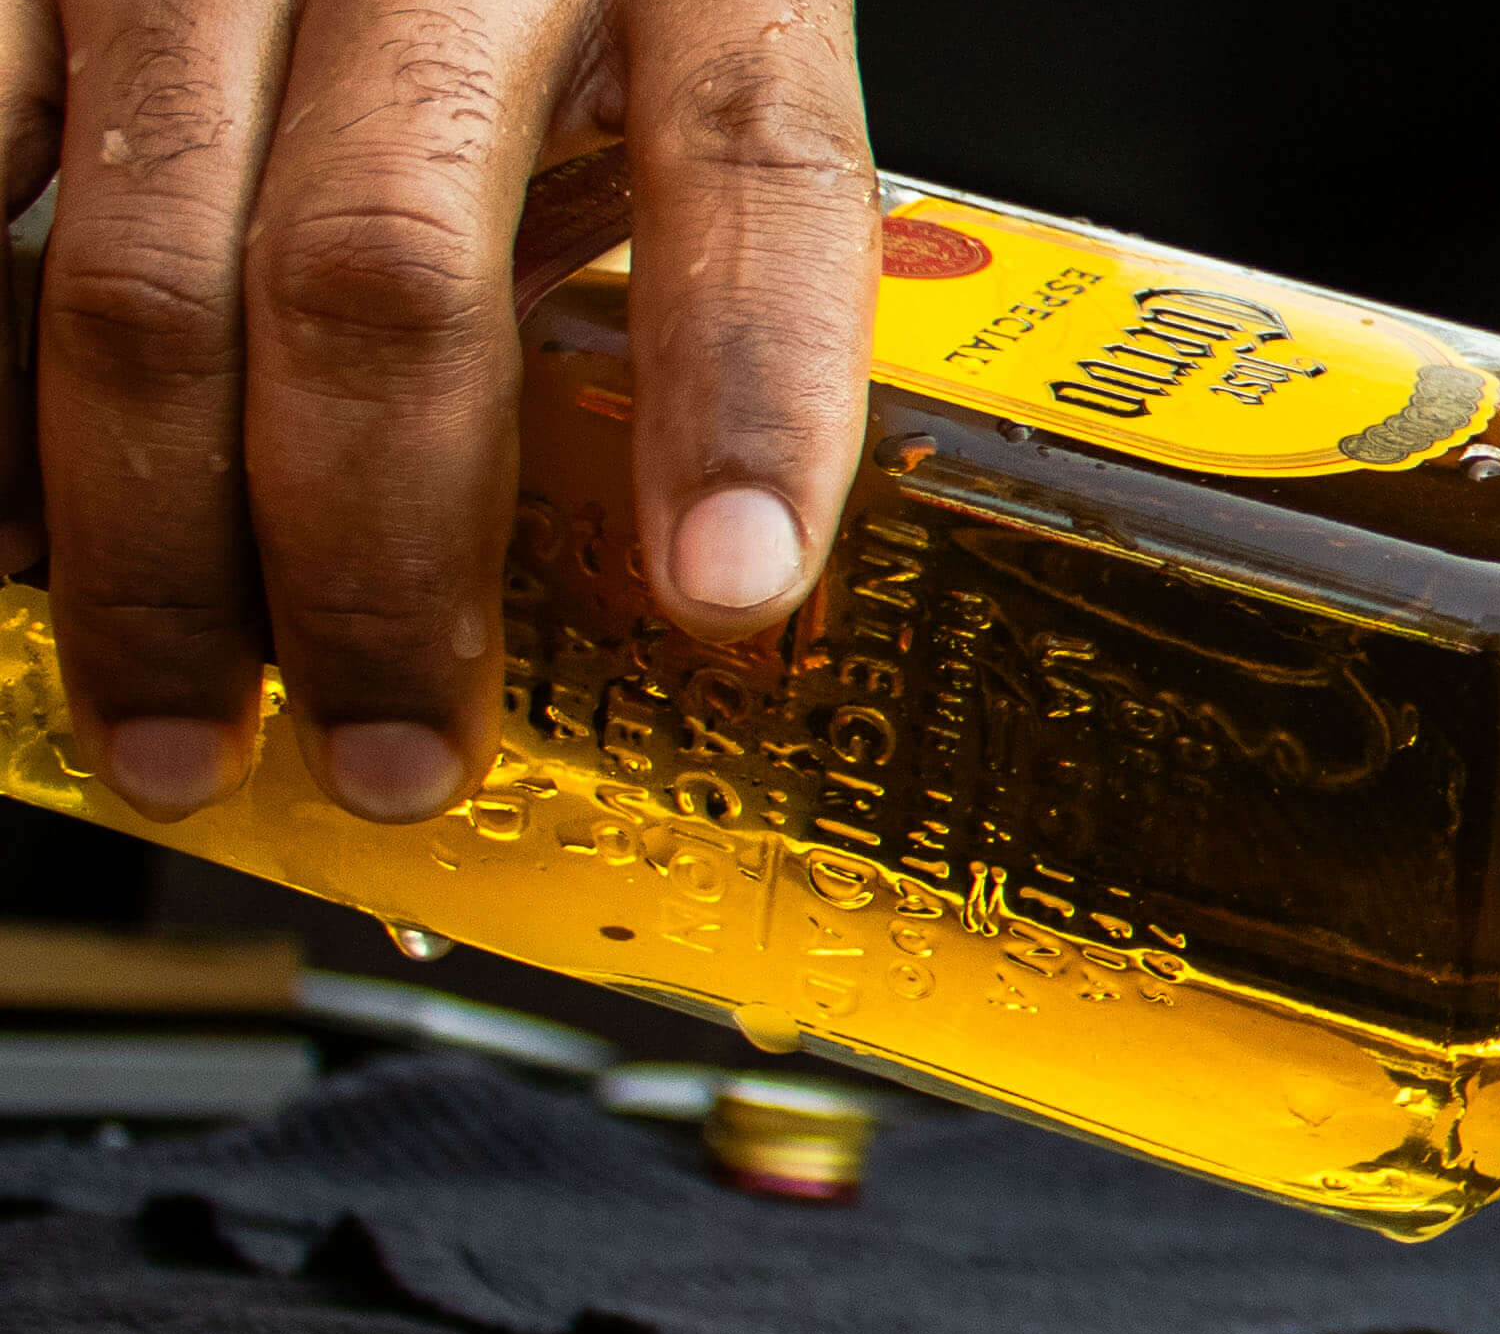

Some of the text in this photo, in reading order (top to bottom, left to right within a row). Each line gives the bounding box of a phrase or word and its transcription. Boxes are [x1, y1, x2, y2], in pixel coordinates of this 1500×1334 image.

[943, 266, 1105, 366] ESPECIAL
[1047, 285, 1292, 419] Cuervo
[1209, 342, 1329, 405] Jose
[806, 516, 931, 1020] INTEGRIDAD
